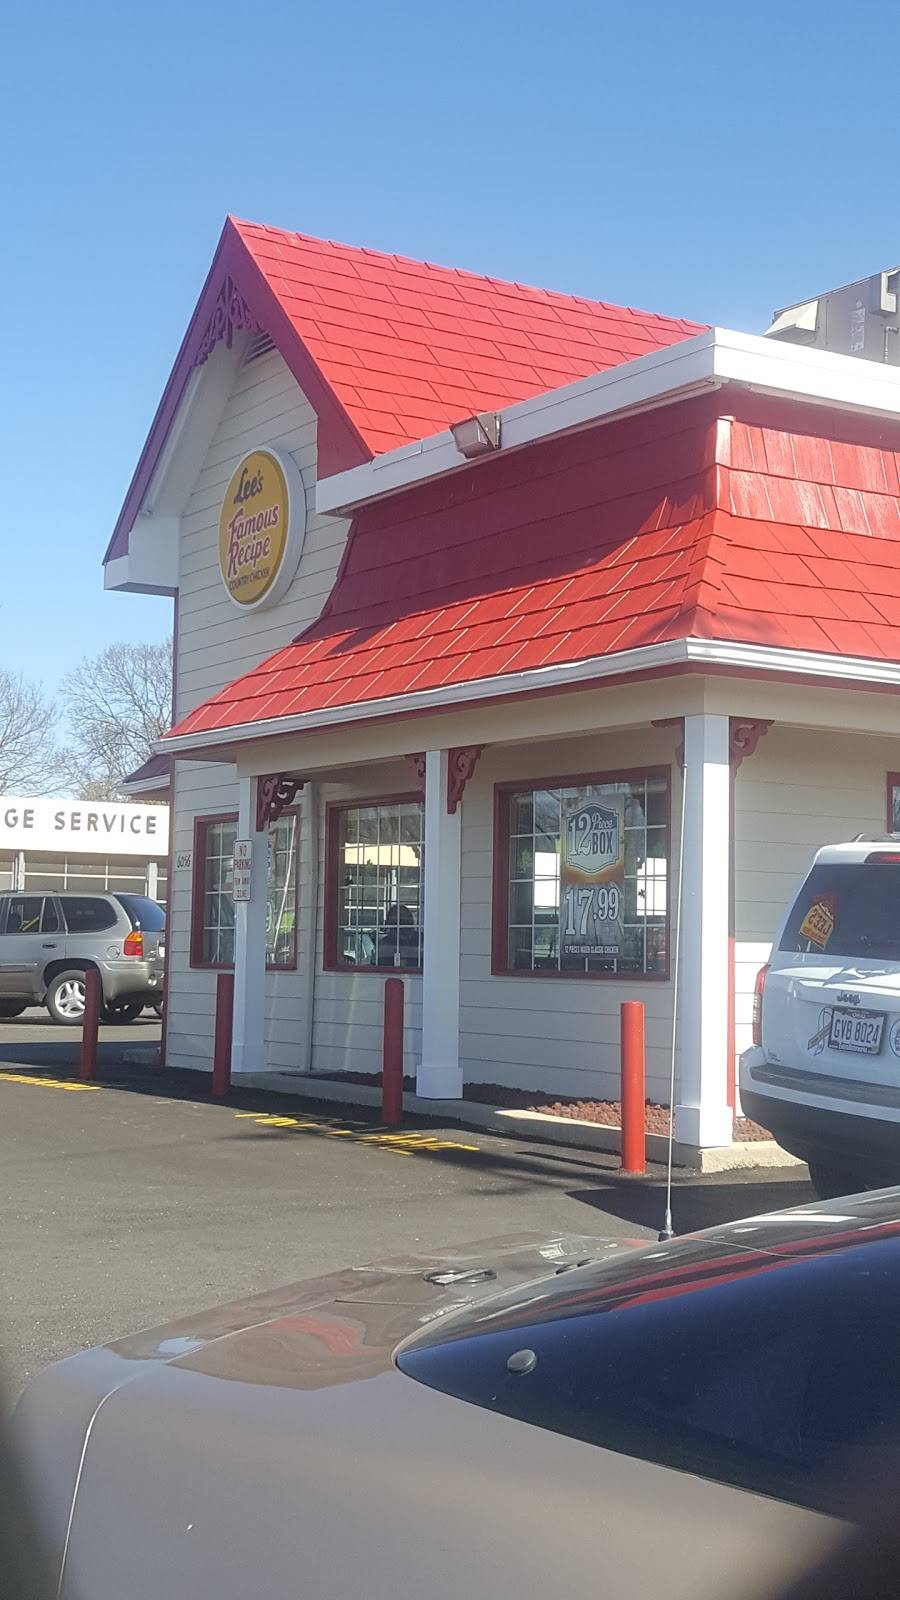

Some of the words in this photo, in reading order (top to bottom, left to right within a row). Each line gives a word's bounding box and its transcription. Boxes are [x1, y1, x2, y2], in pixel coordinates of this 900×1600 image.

[233, 467, 265, 504] Lee's
[227, 504, 280, 548] Famous
[227, 535, 271, 579] Recipe
[229, 576, 250, 592] COUNTRY
[250, 567, 270, 584] CHICKEN
[4, 808, 35, 829] GE
[54, 811, 157, 834] SERVICE
[592, 812, 613, 830] Piece
[568, 813, 592, 856] 12
[592, 831, 613, 855] BOX
[239, 844, 248, 857] NO
[564, 887, 619, 936] 17.99
[836, 991, 860, 1006] Jeep
[834, 1019, 853, 1041] GVB
[854, 1021, 880, 1044] 8024
